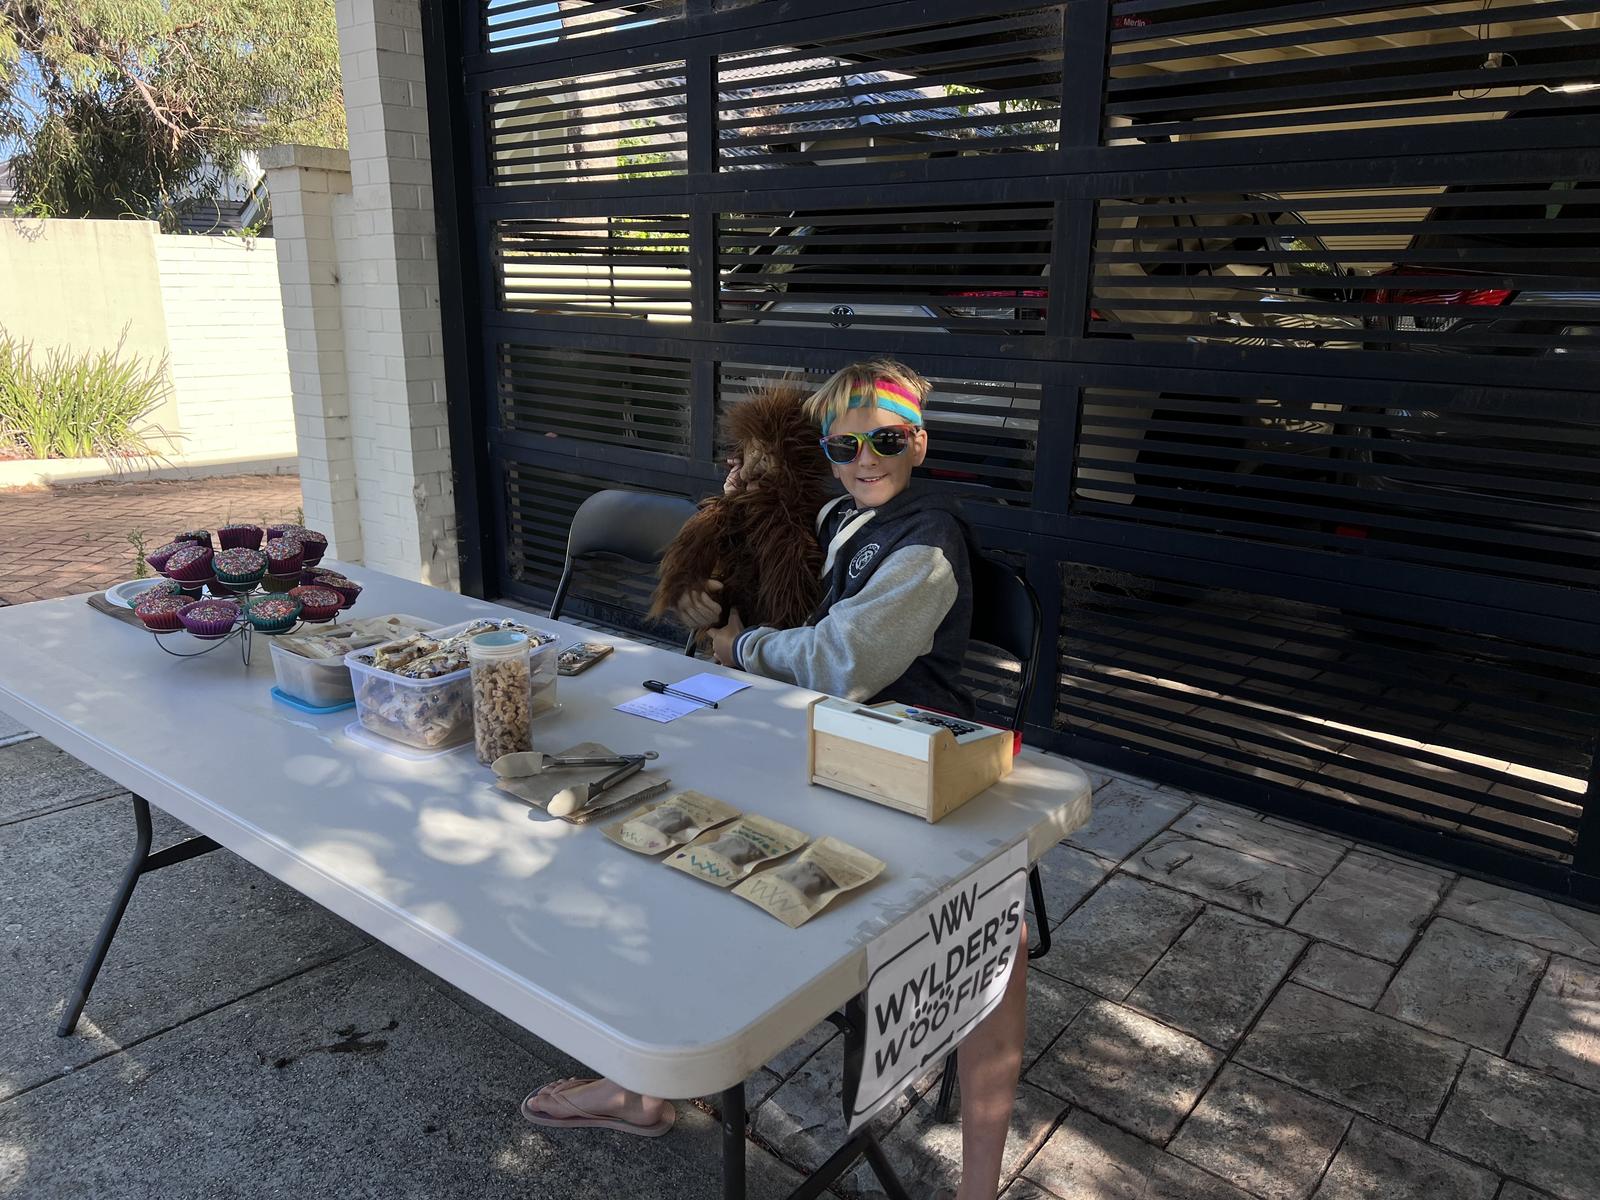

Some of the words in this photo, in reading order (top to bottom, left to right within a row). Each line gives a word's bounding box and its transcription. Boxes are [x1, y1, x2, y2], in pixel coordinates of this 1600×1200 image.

[1123, 17, 1146, 27] Merlin
[874, 900, 1020, 1036] WYLDER'S
[874, 945, 1012, 1078] WOOFIES
